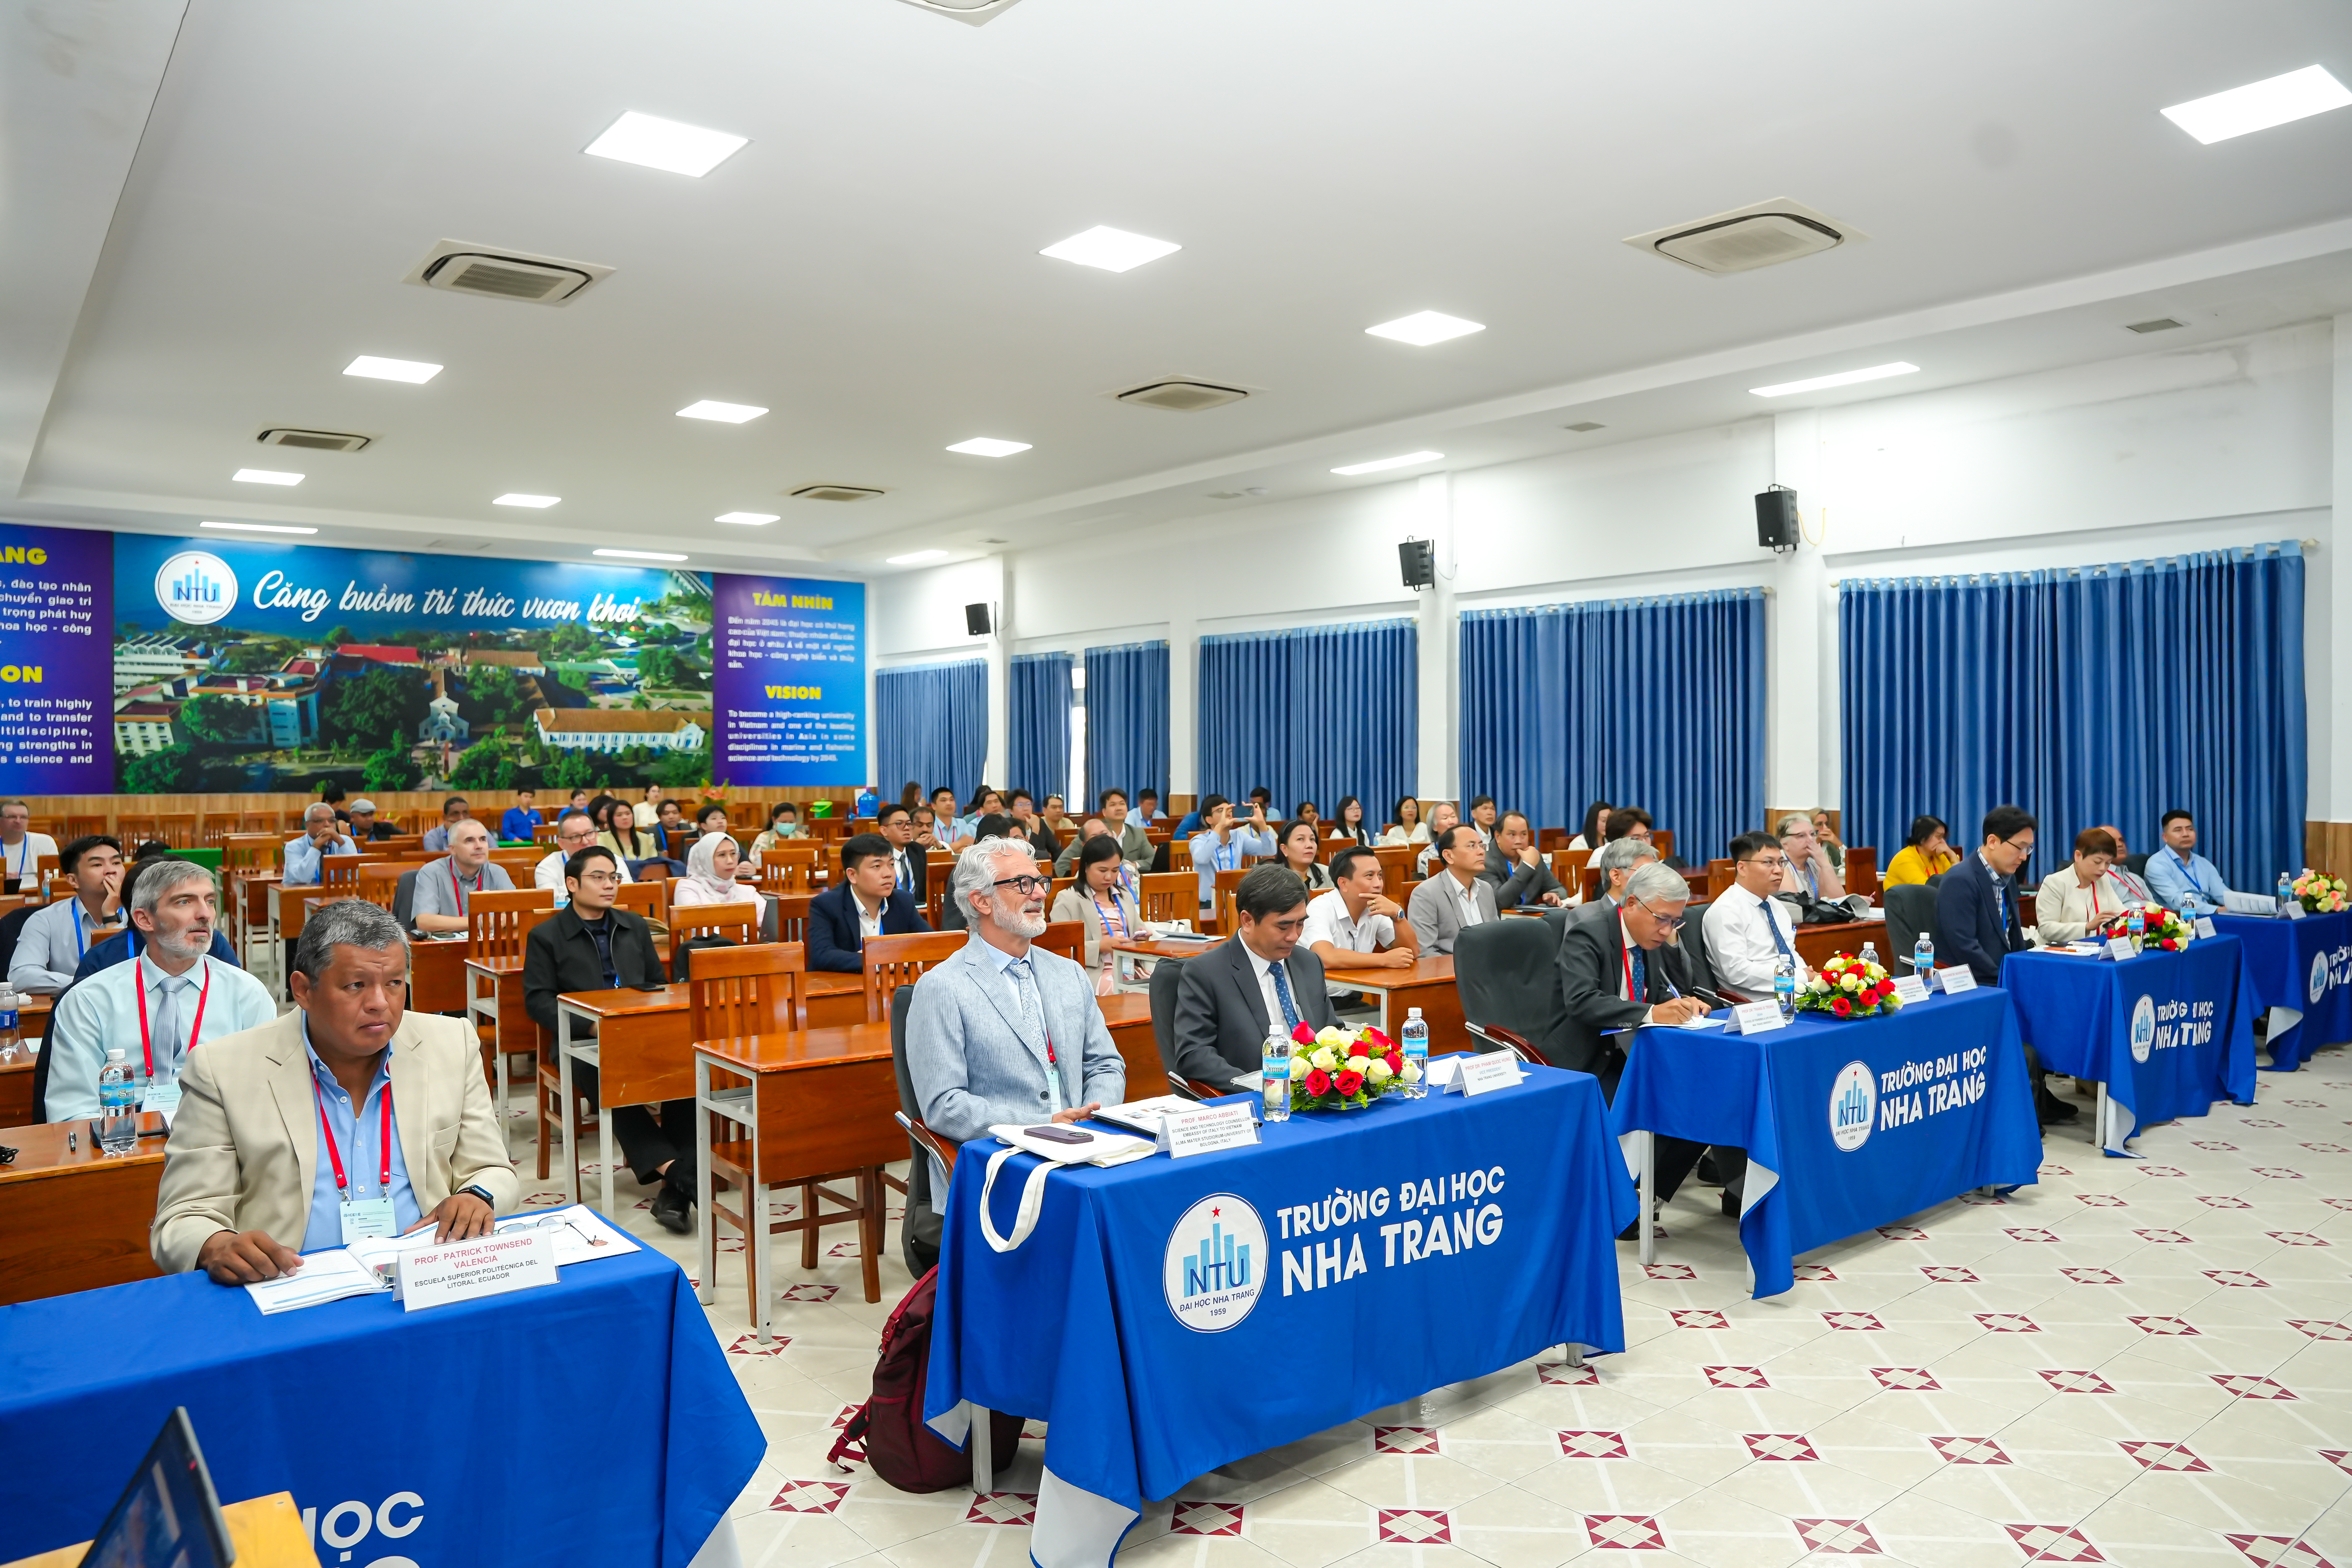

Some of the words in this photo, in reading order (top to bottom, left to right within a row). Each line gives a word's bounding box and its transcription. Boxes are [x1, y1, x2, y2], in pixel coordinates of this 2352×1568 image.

[0, 546, 47, 565] NG
[11, 579, 34, 589] đào
[38, 581, 58, 592] tạo
[62, 582, 91, 592] nhân
[48, 595, 74, 606] giao
[178, 587, 216, 602] NTU
[253, 570, 331, 622] Căng
[461, 586, 516, 618] thức
[522, 597, 581, 620] vươn
[3, 607, 35, 619] trọng
[40, 609, 66, 620] phát
[70, 610, 91, 622] huy
[26, 621, 47, 633] học
[62, 623, 91, 635] công
[0, 665, 42, 683] ON
[765, 684, 821, 700] VISION
[8, 698, 21, 707] to
[24, 698, 52, 708] train
[56, 699, 92, 710] highly
[1, 712, 23, 721] and
[29, 713, 41, 722] to
[46, 713, 92, 722] transfer
[739, 710, 768, 718] become
[775, 710, 820, 720] high-ranking
[19, 740, 76, 751] strengths
[82, 740, 92, 750] in
[728, 743, 768, 752] disciplines
[15, 754, 63, 764] science
[70, 754, 92, 764] and
[771, 754, 810, 763] technology
[1881, 1061, 1933, 1094] TRƯỜNG
[1936, 1053, 1957, 1081] ĐẠI
[1963, 1045, 1986, 1073] HỌC
[1880, 1091, 1923, 1132] NHA
[1928, 1071, 1986, 1116] TRANG
[1198, 1114, 1217, 1122] MARCO
[1840, 1104, 1866, 1126] NTU
[1198, 1121, 1224, 1129] TECHNOLOGY
[1201, 1130, 1246, 1141] STUDIORUM-UNIVERSITY
[1277, 1187, 1390, 1239] TRƯỜNG
[1400, 1178, 1445, 1215] ĐẠI
[1451, 1166, 1506, 1206] HỌC
[414, 1255, 442, 1266] PROF.
[444, 1247, 482, 1260] PATRICK
[484, 1238, 532, 1253] TOWNSEND
[1282, 1233, 1367, 1297] NHA
[1380, 1203, 1504, 1267] TRANG
[454, 1255, 498, 1269] VALENCIA
[414, 1277, 446, 1287] ESCUELA
[447, 1270, 481, 1281] SUPERIOR
[482, 1262, 524, 1275] POLITÉCNICA
[447, 1279, 477, 1289] LITORAL,
[478, 1272, 510, 1283] ECUADOR
[1190, 1259, 1244, 1296] NTU
[1180, 1303, 1192, 1312] ĐẠI
[1194, 1298, 1210, 1308] HỌC
[1213, 1295, 1229, 1305] NHA
[1232, 1289, 1255, 1301] TRANG
[1210, 1308, 1226, 1316] 1959
